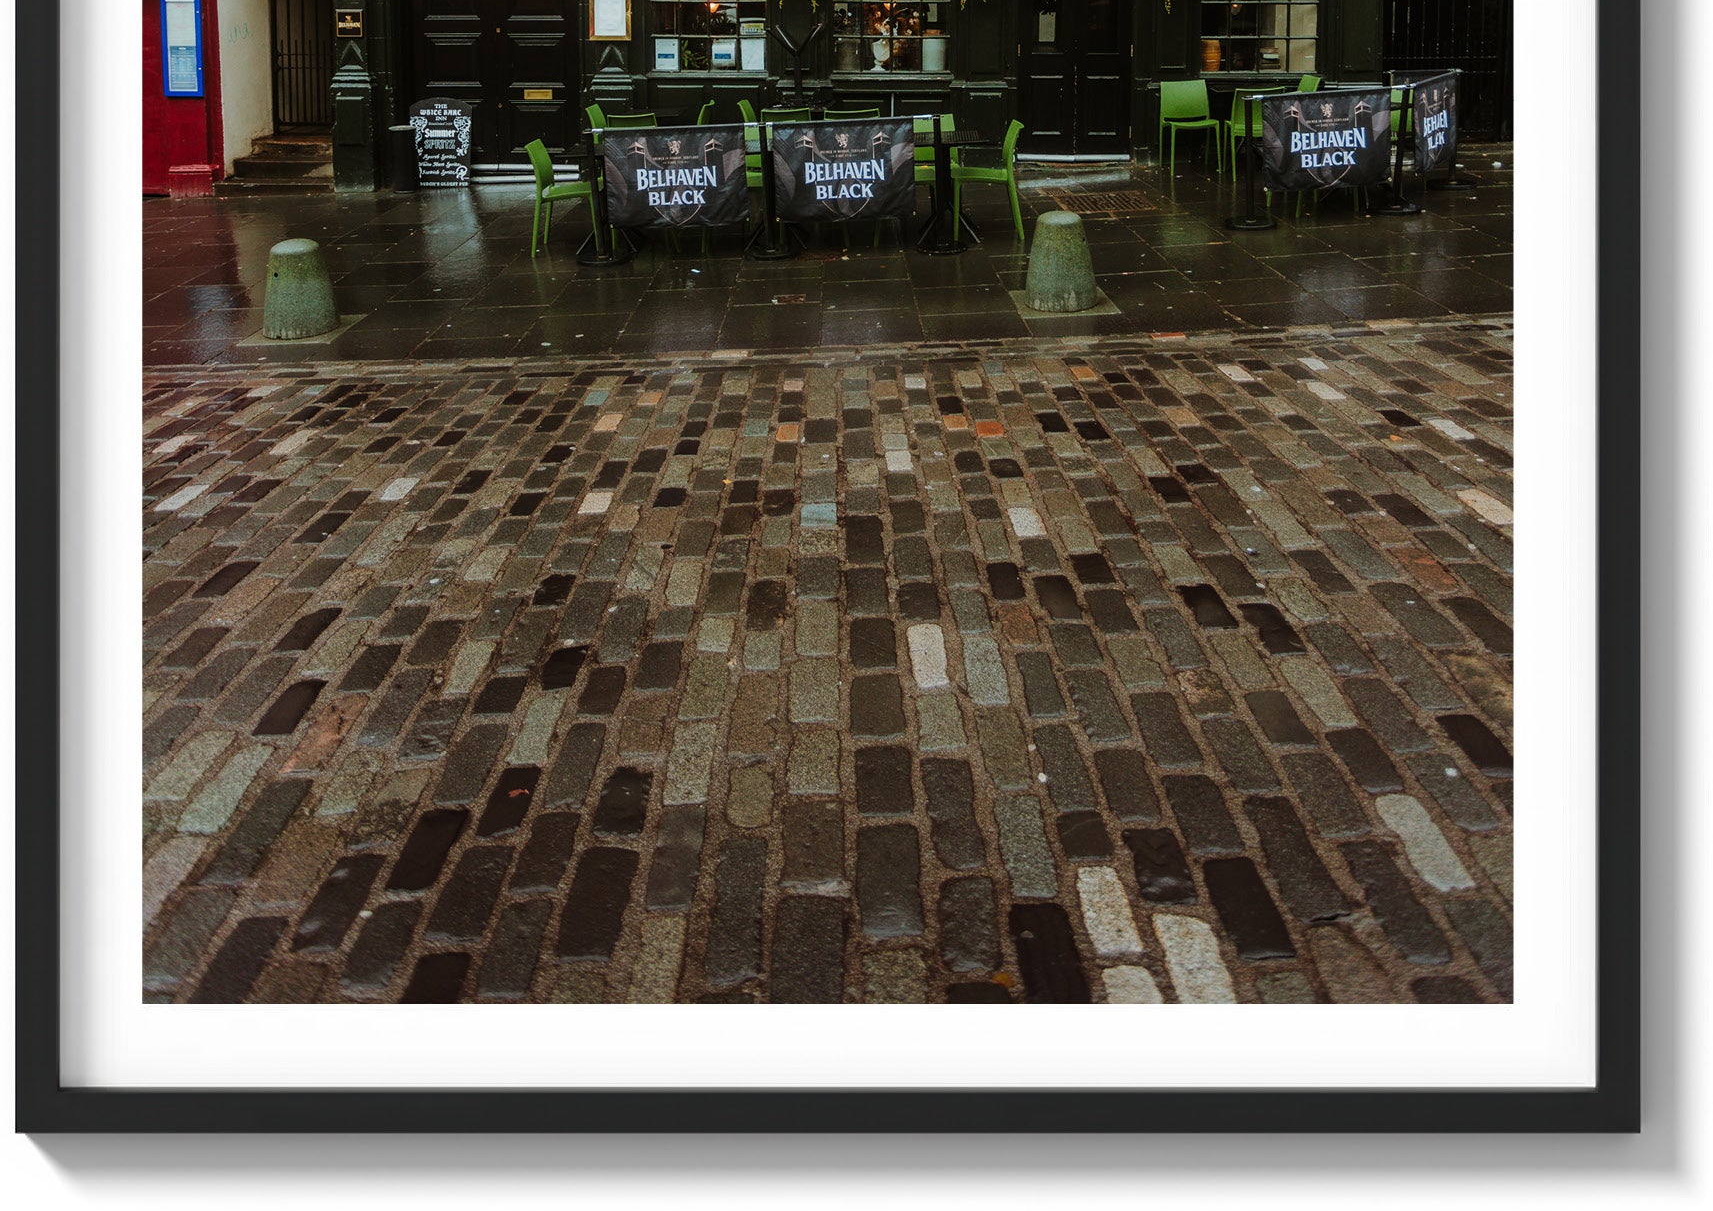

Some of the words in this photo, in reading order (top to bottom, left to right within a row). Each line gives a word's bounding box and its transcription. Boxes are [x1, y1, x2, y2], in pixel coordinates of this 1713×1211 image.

[424, 128, 456, 138] Summer
[1290, 127, 1367, 153] BELHAVEN
[423, 139, 456, 150] SPRITZ
[1301, 151, 1356, 168] BLACK
[636, 165, 717, 191] BELHAVEN
[804, 159, 885, 184] BELHAVEN
[648, 190, 706, 206] BLACK
[816, 183, 874, 200] BLACK
